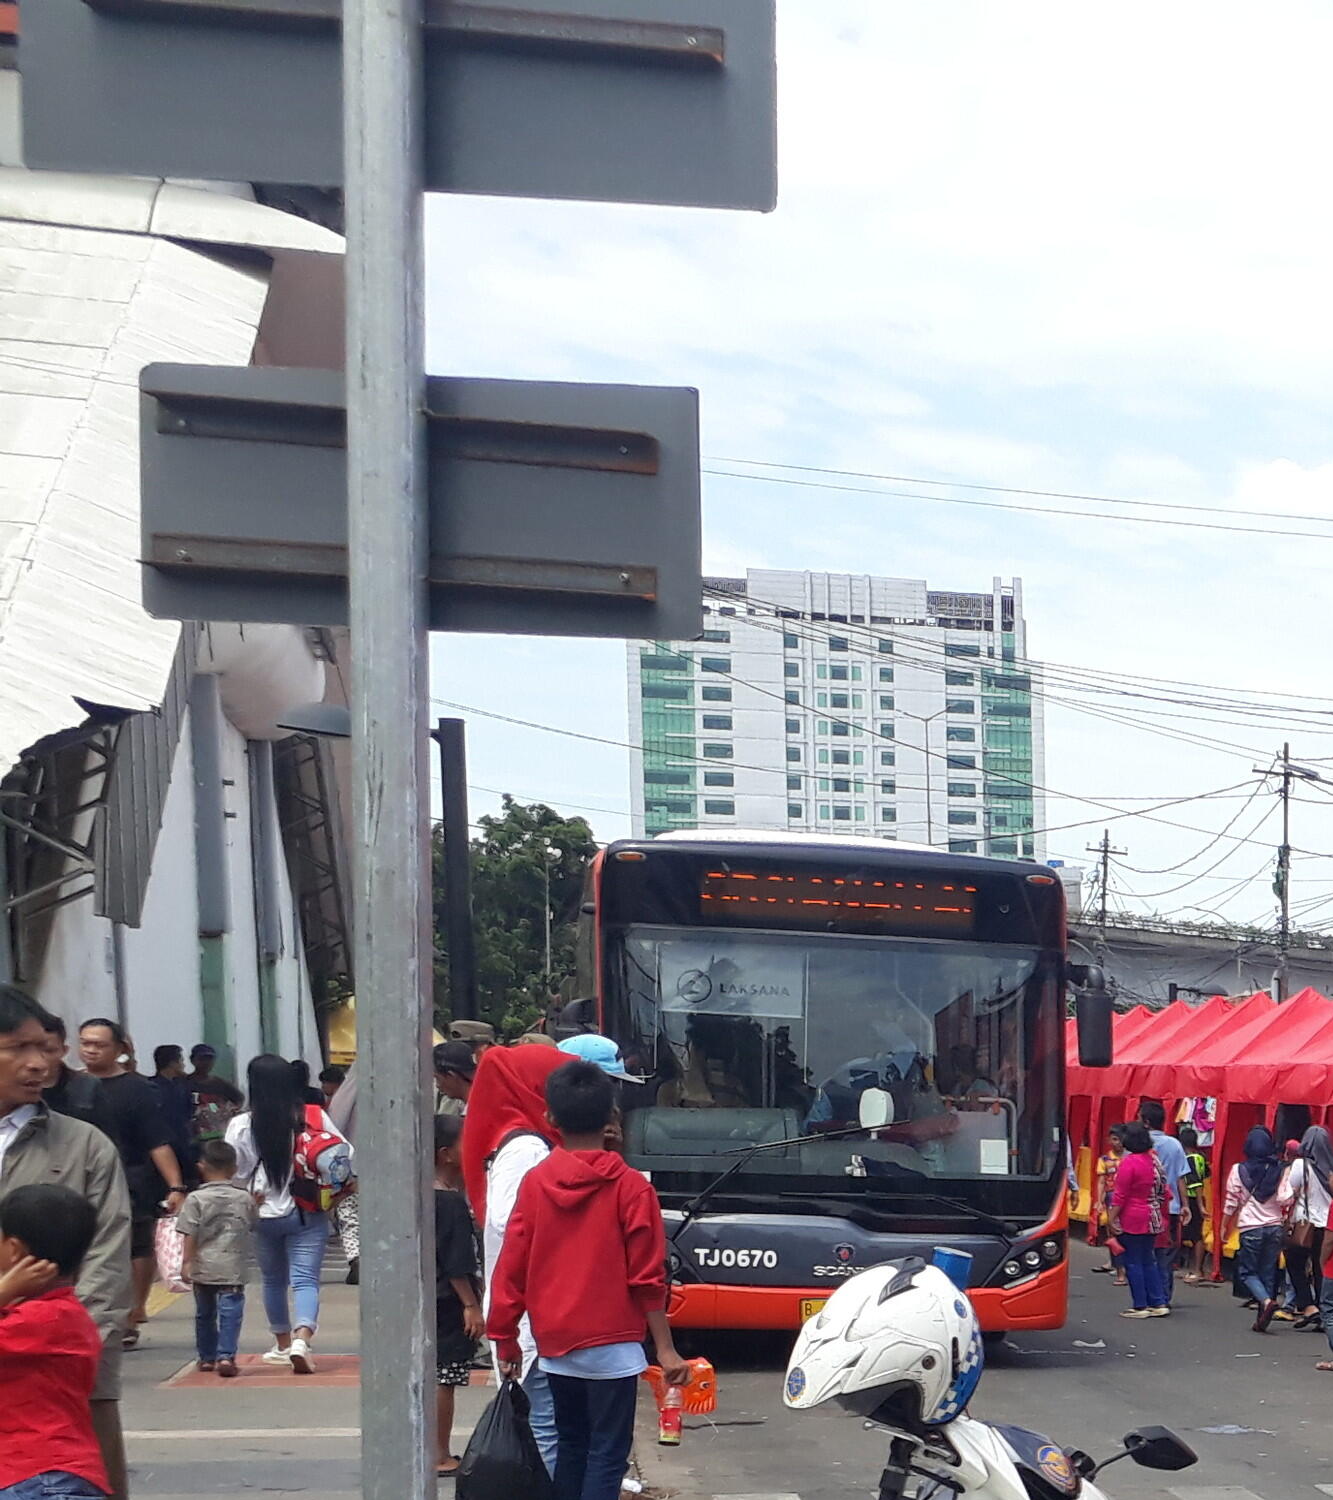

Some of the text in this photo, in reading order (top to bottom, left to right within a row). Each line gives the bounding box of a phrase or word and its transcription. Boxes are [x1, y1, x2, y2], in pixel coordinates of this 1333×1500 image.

[720, 983, 790, 997] LAKSANA
[694, 1248, 778, 1268] TJ0670
[804, 1302, 813, 1317] B
